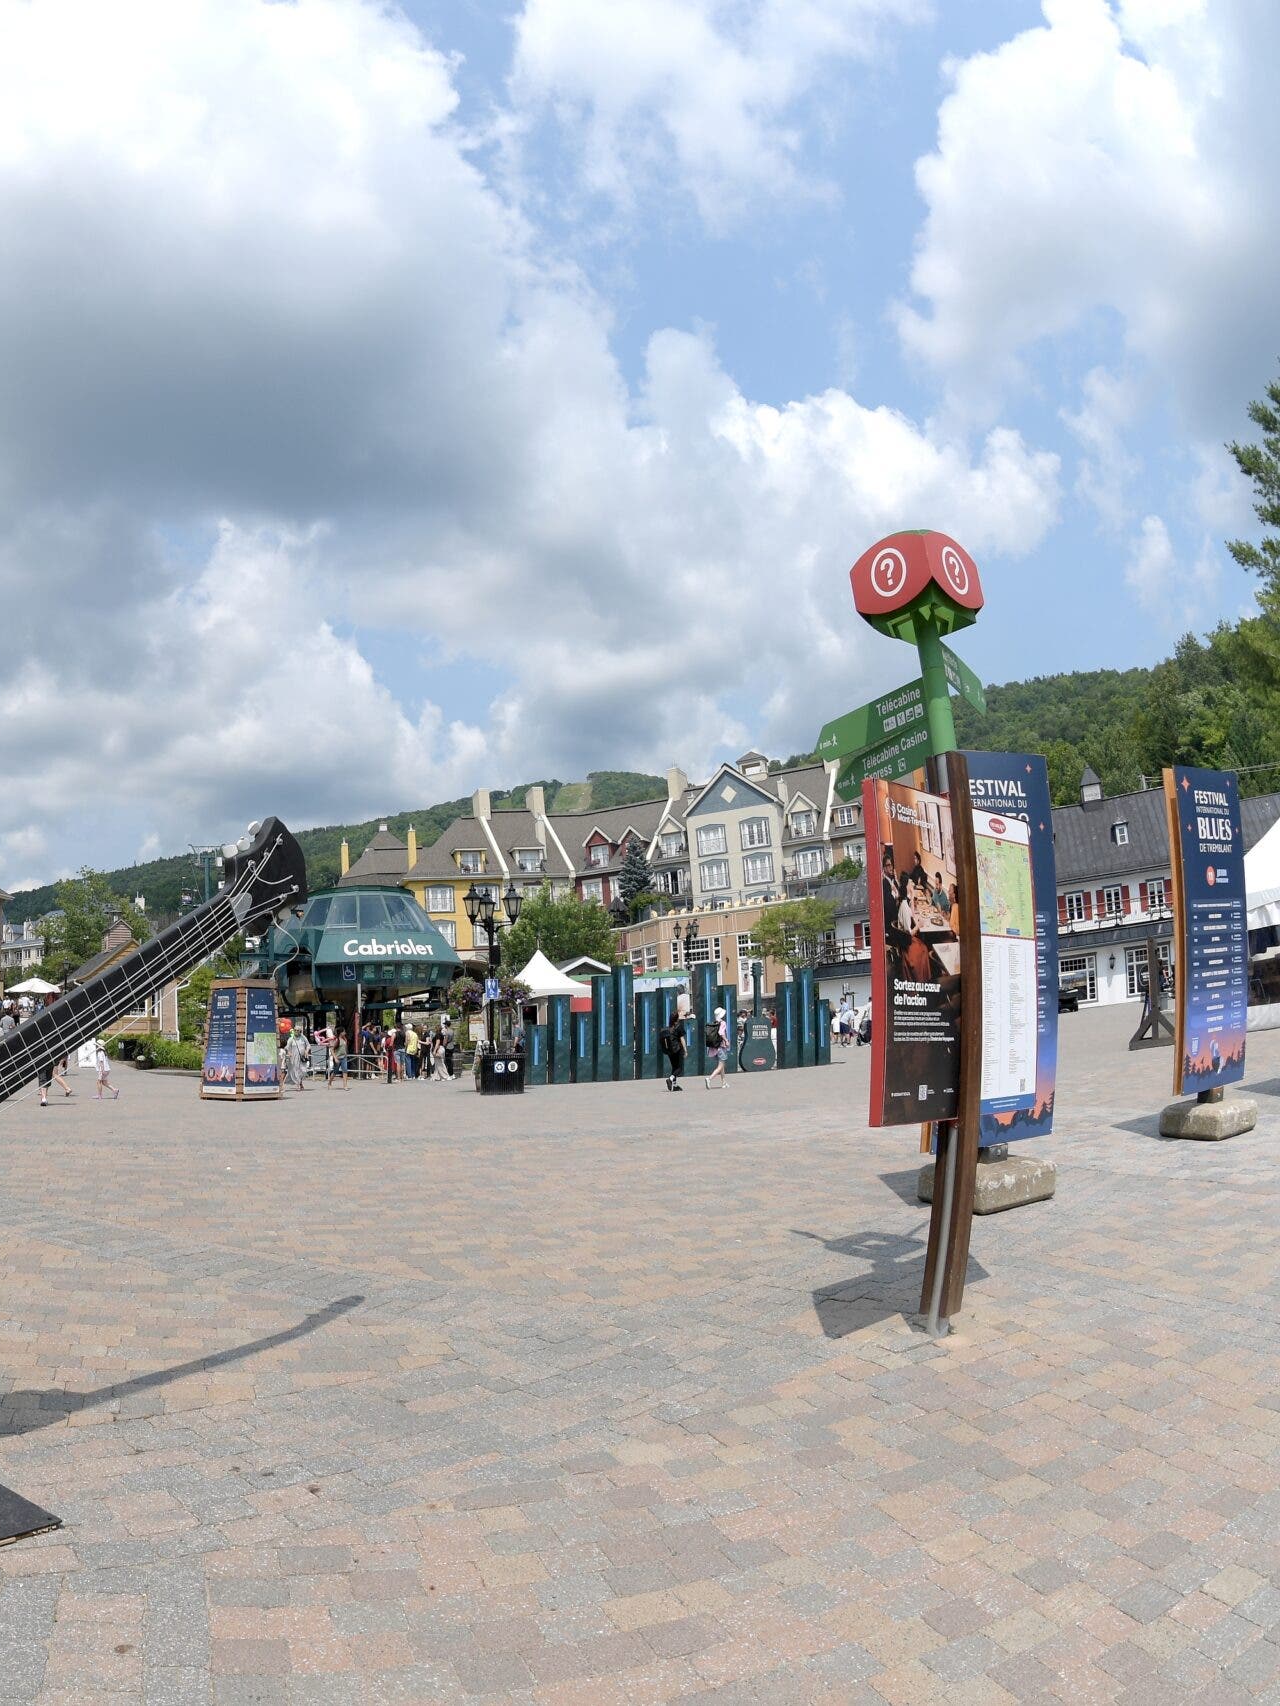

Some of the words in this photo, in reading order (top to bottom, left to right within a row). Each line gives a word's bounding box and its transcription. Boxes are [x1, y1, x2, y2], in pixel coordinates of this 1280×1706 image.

[876, 687, 921, 716] Télécabine
[863, 746, 900, 771] Télécabine
[900, 729, 928, 750] Casino
[864, 764, 892, 780] Express
[968, 779, 1026, 796] ESTIVAL
[971, 798, 1016, 807] ERNATIONAL
[1018, 800, 1027, 808] DU
[1194, 790, 1229, 806] FESTIVAL
[897, 804, 917, 817] Casino
[1197, 817, 1232, 840] BLUES
[1200, 843, 1206, 852] DE
[1207, 844, 1232, 853] TREMBLANT
[343, 939, 434, 956] Cabriolet
[894, 979, 915, 991] Sortez
[916, 982, 924, 992] au
[894, 994, 903, 1005] de
[904, 994, 927, 1006] l'action
